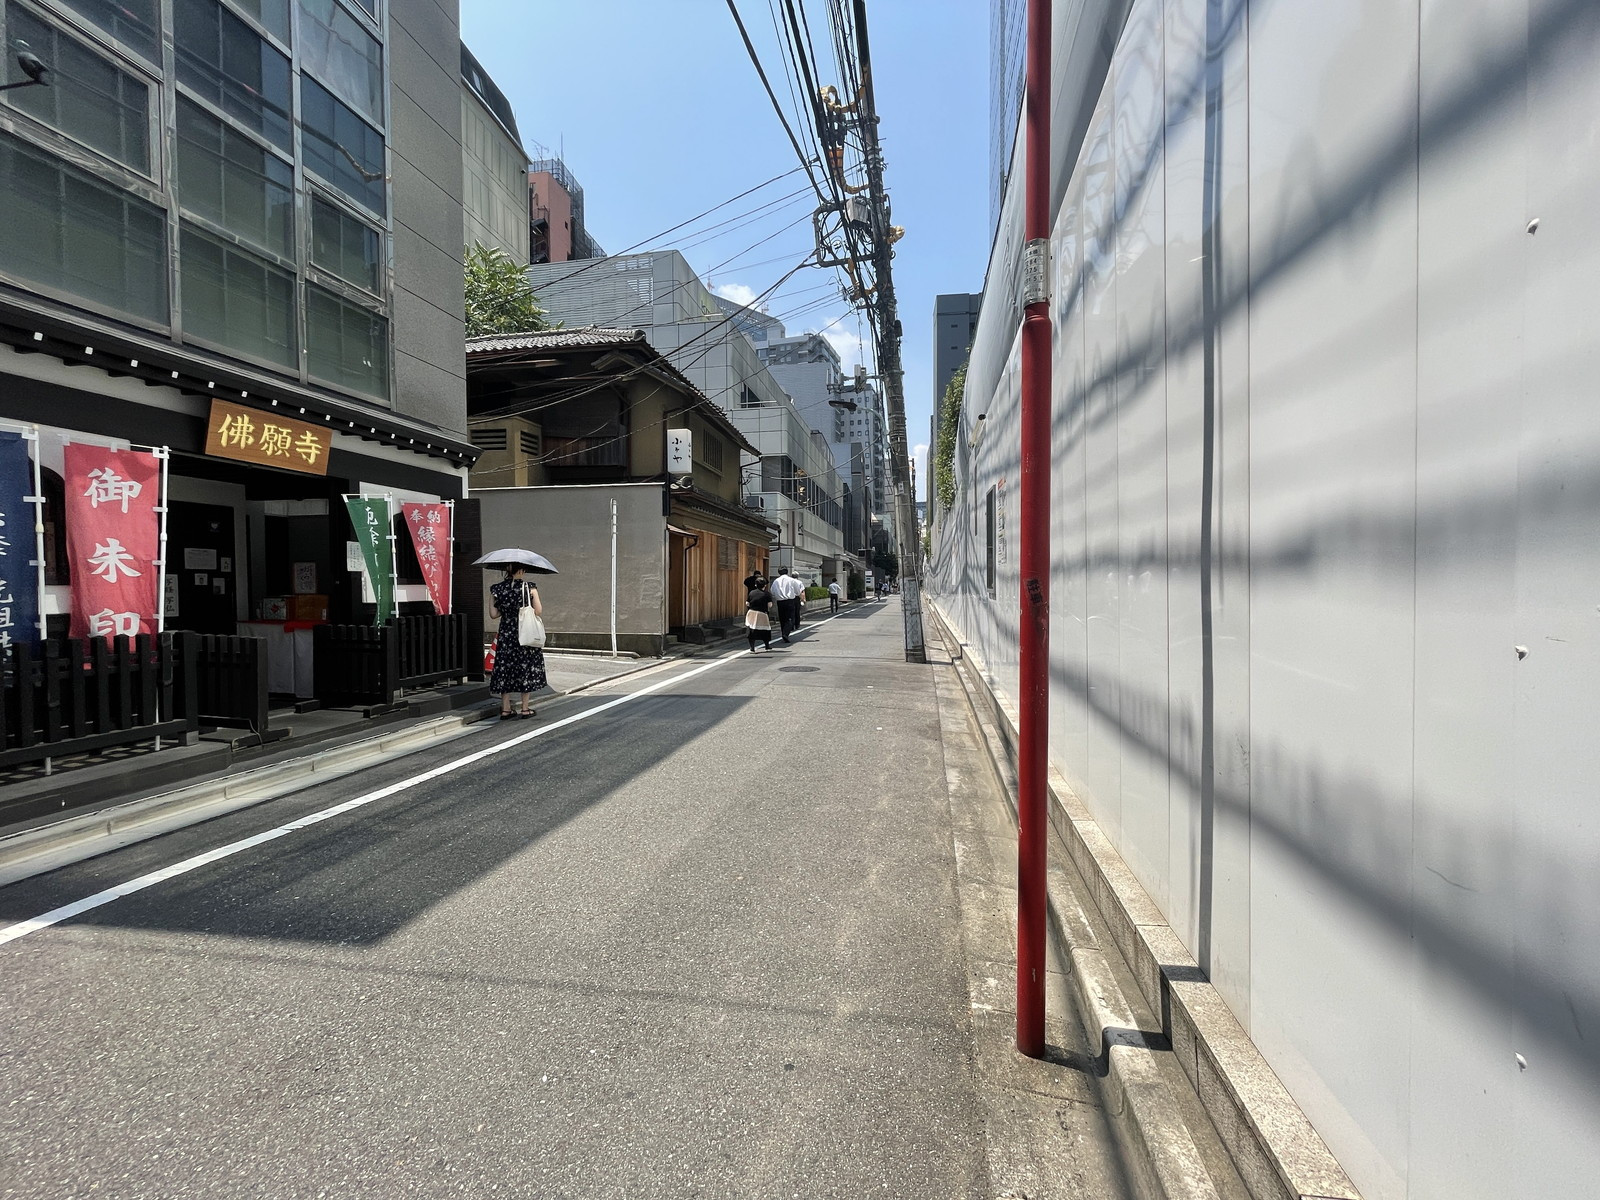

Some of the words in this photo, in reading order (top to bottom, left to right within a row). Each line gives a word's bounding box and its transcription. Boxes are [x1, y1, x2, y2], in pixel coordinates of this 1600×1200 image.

[218, 413, 322, 465] 佛願寺
[410, 508, 441, 524] 奉納
[83, 466, 142, 638] 御朱印
